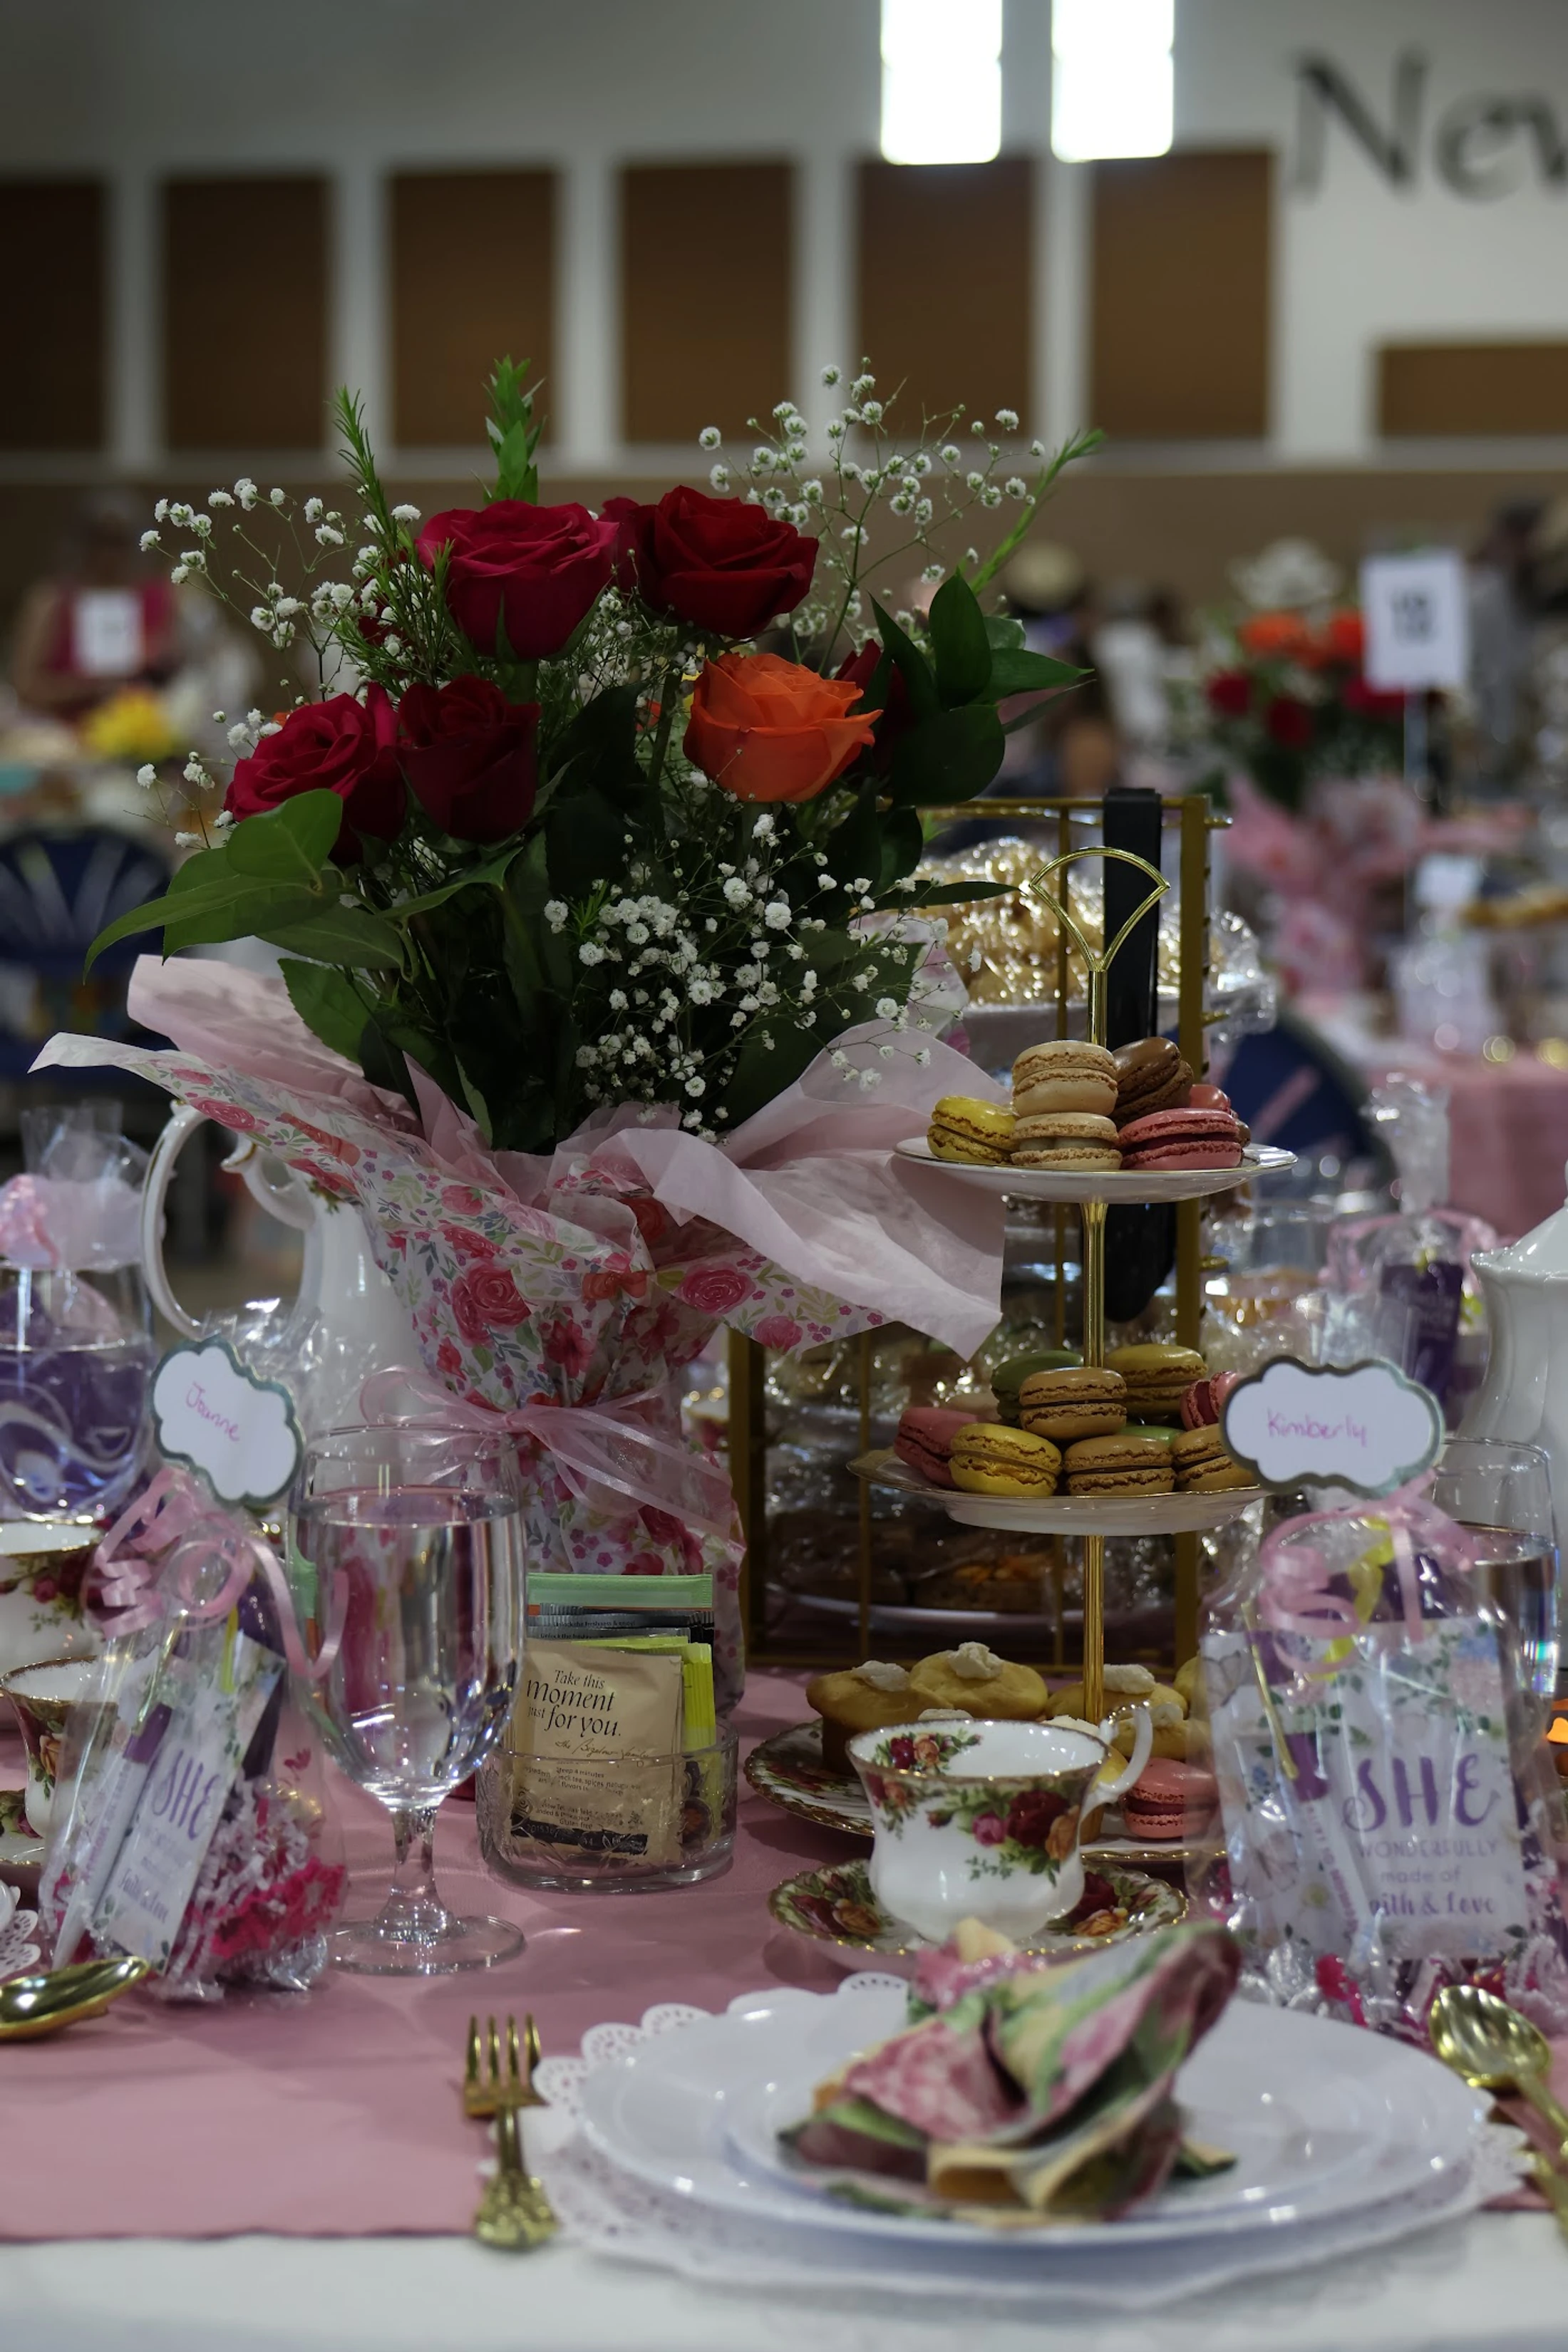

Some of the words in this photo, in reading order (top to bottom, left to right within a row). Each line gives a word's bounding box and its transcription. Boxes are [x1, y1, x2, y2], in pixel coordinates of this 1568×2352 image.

[1268, 1409, 1367, 1447] Kimberly
[555, 1669, 580, 1686] Take
[583, 1673, 606, 1690] this
[527, 1705, 546, 1718] just
[544, 1704, 577, 1732] for
[579, 1716, 621, 1738] you.
[555, 1739, 571, 1750] The
[572, 1738, 619, 1758] Bigelow
[152, 1748, 220, 1841] SHE
[1341, 1752, 1501, 1832] SHE
[1380, 1865, 1434, 1882] made
[1440, 1864, 1462, 1884] of
